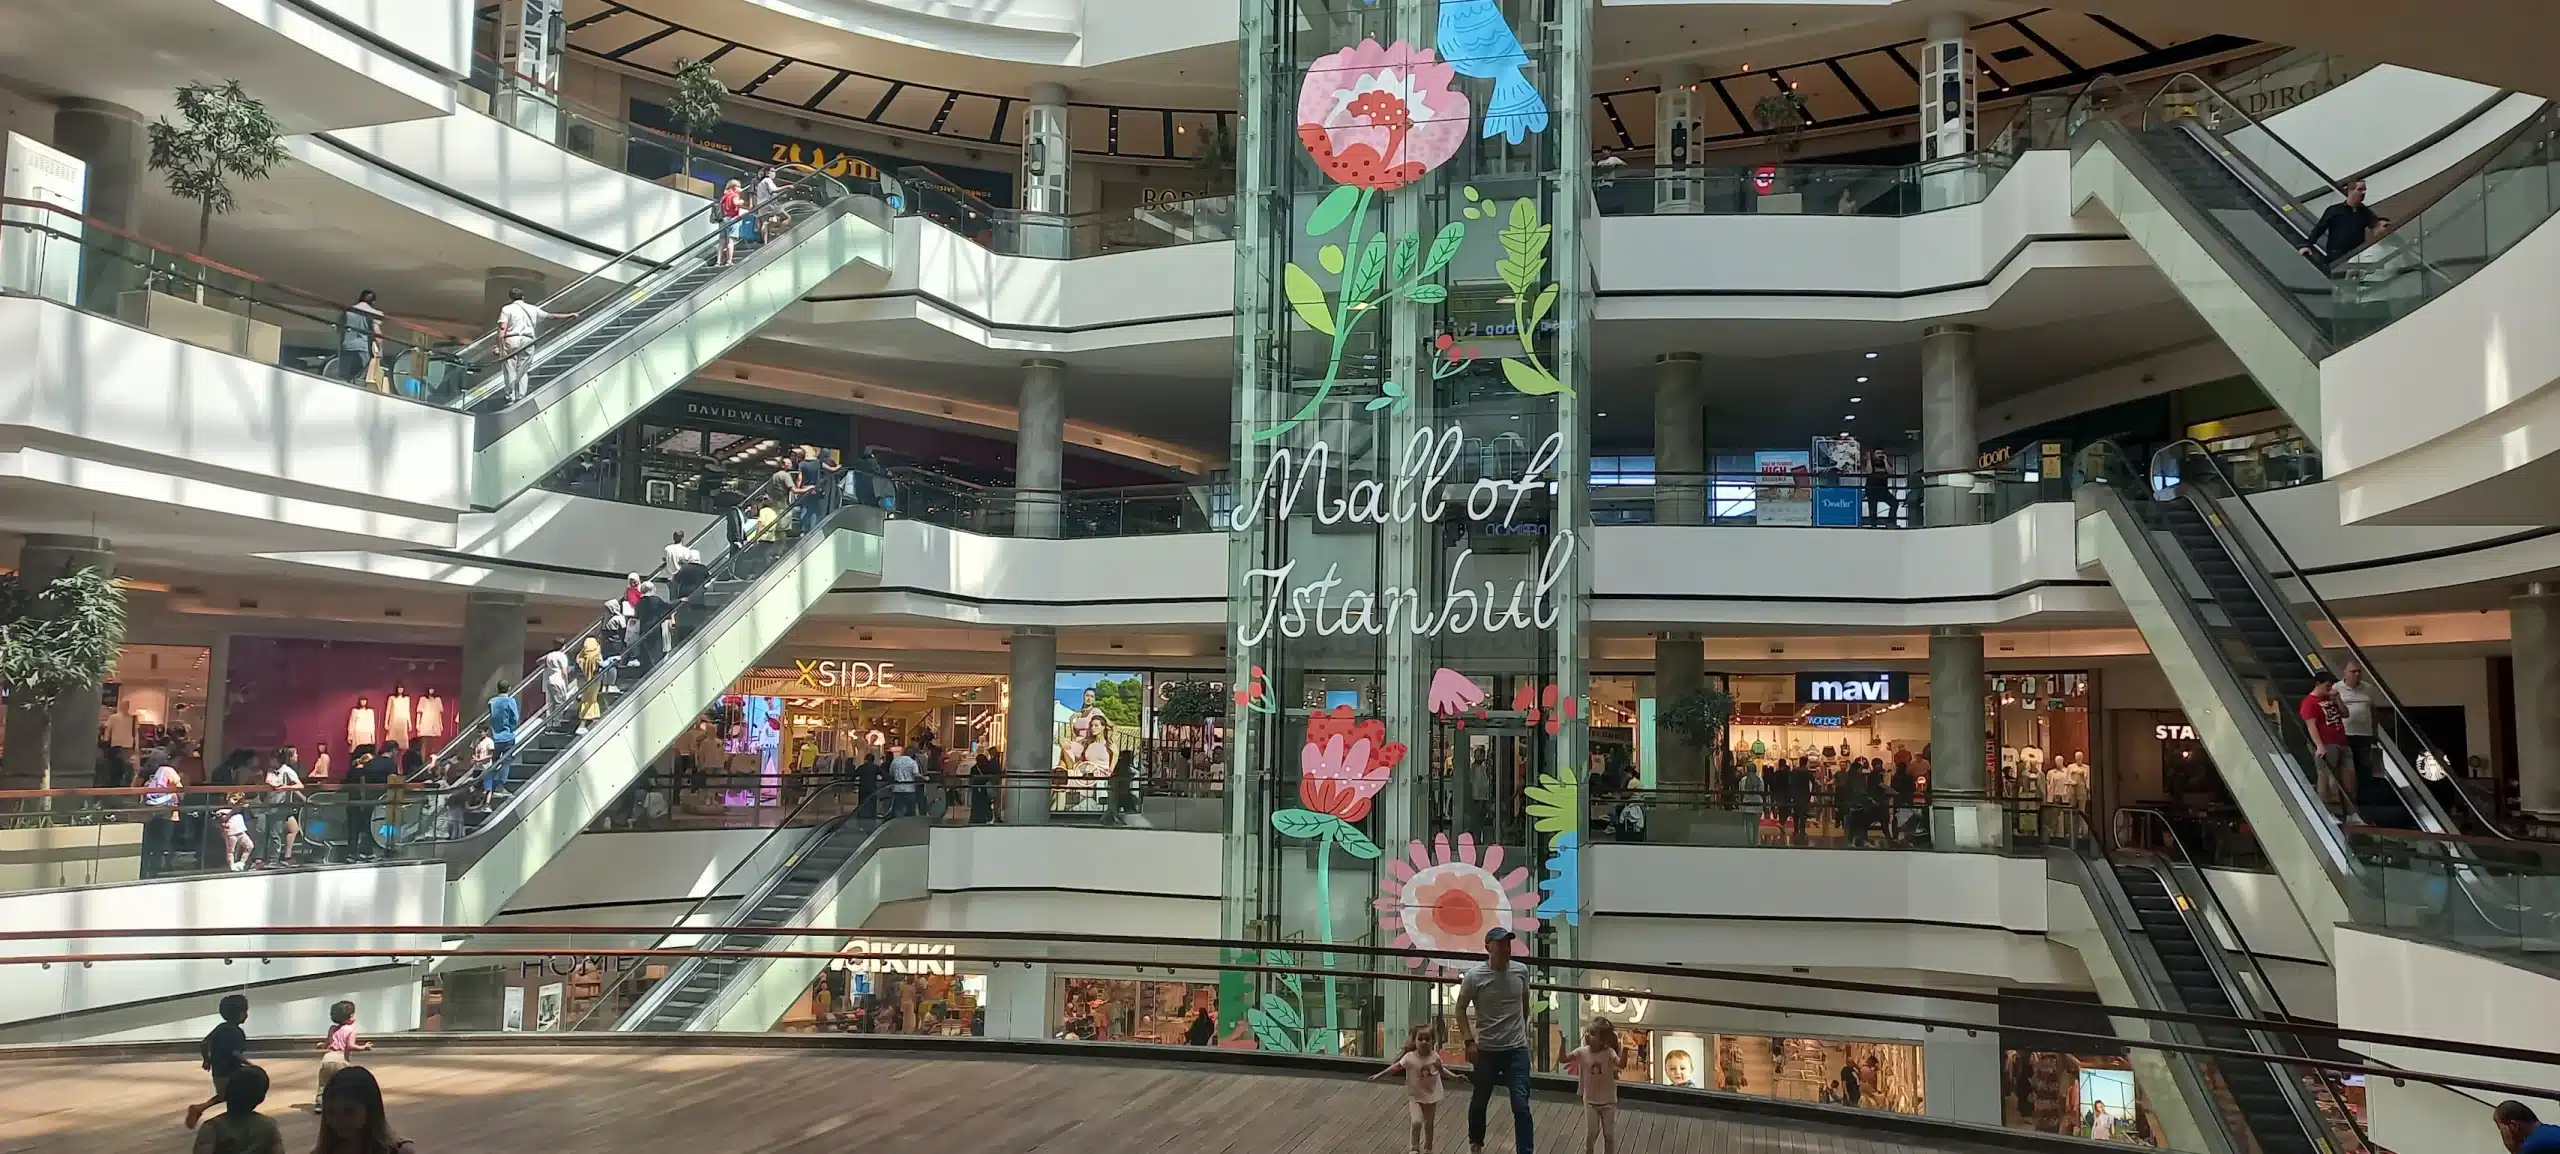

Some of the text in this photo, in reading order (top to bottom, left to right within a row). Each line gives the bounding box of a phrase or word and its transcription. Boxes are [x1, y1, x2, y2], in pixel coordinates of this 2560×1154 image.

[688, 402, 804, 428] DAVID WALKER
[1231, 425, 1564, 532] Mall of
[1237, 529, 1575, 648] Istanbul
[795, 659, 895, 689] XSIDE
[1811, 674, 1889, 701] mavi
[2155, 724, 2200, 740] STA
[520, 955, 634, 979] HOME
